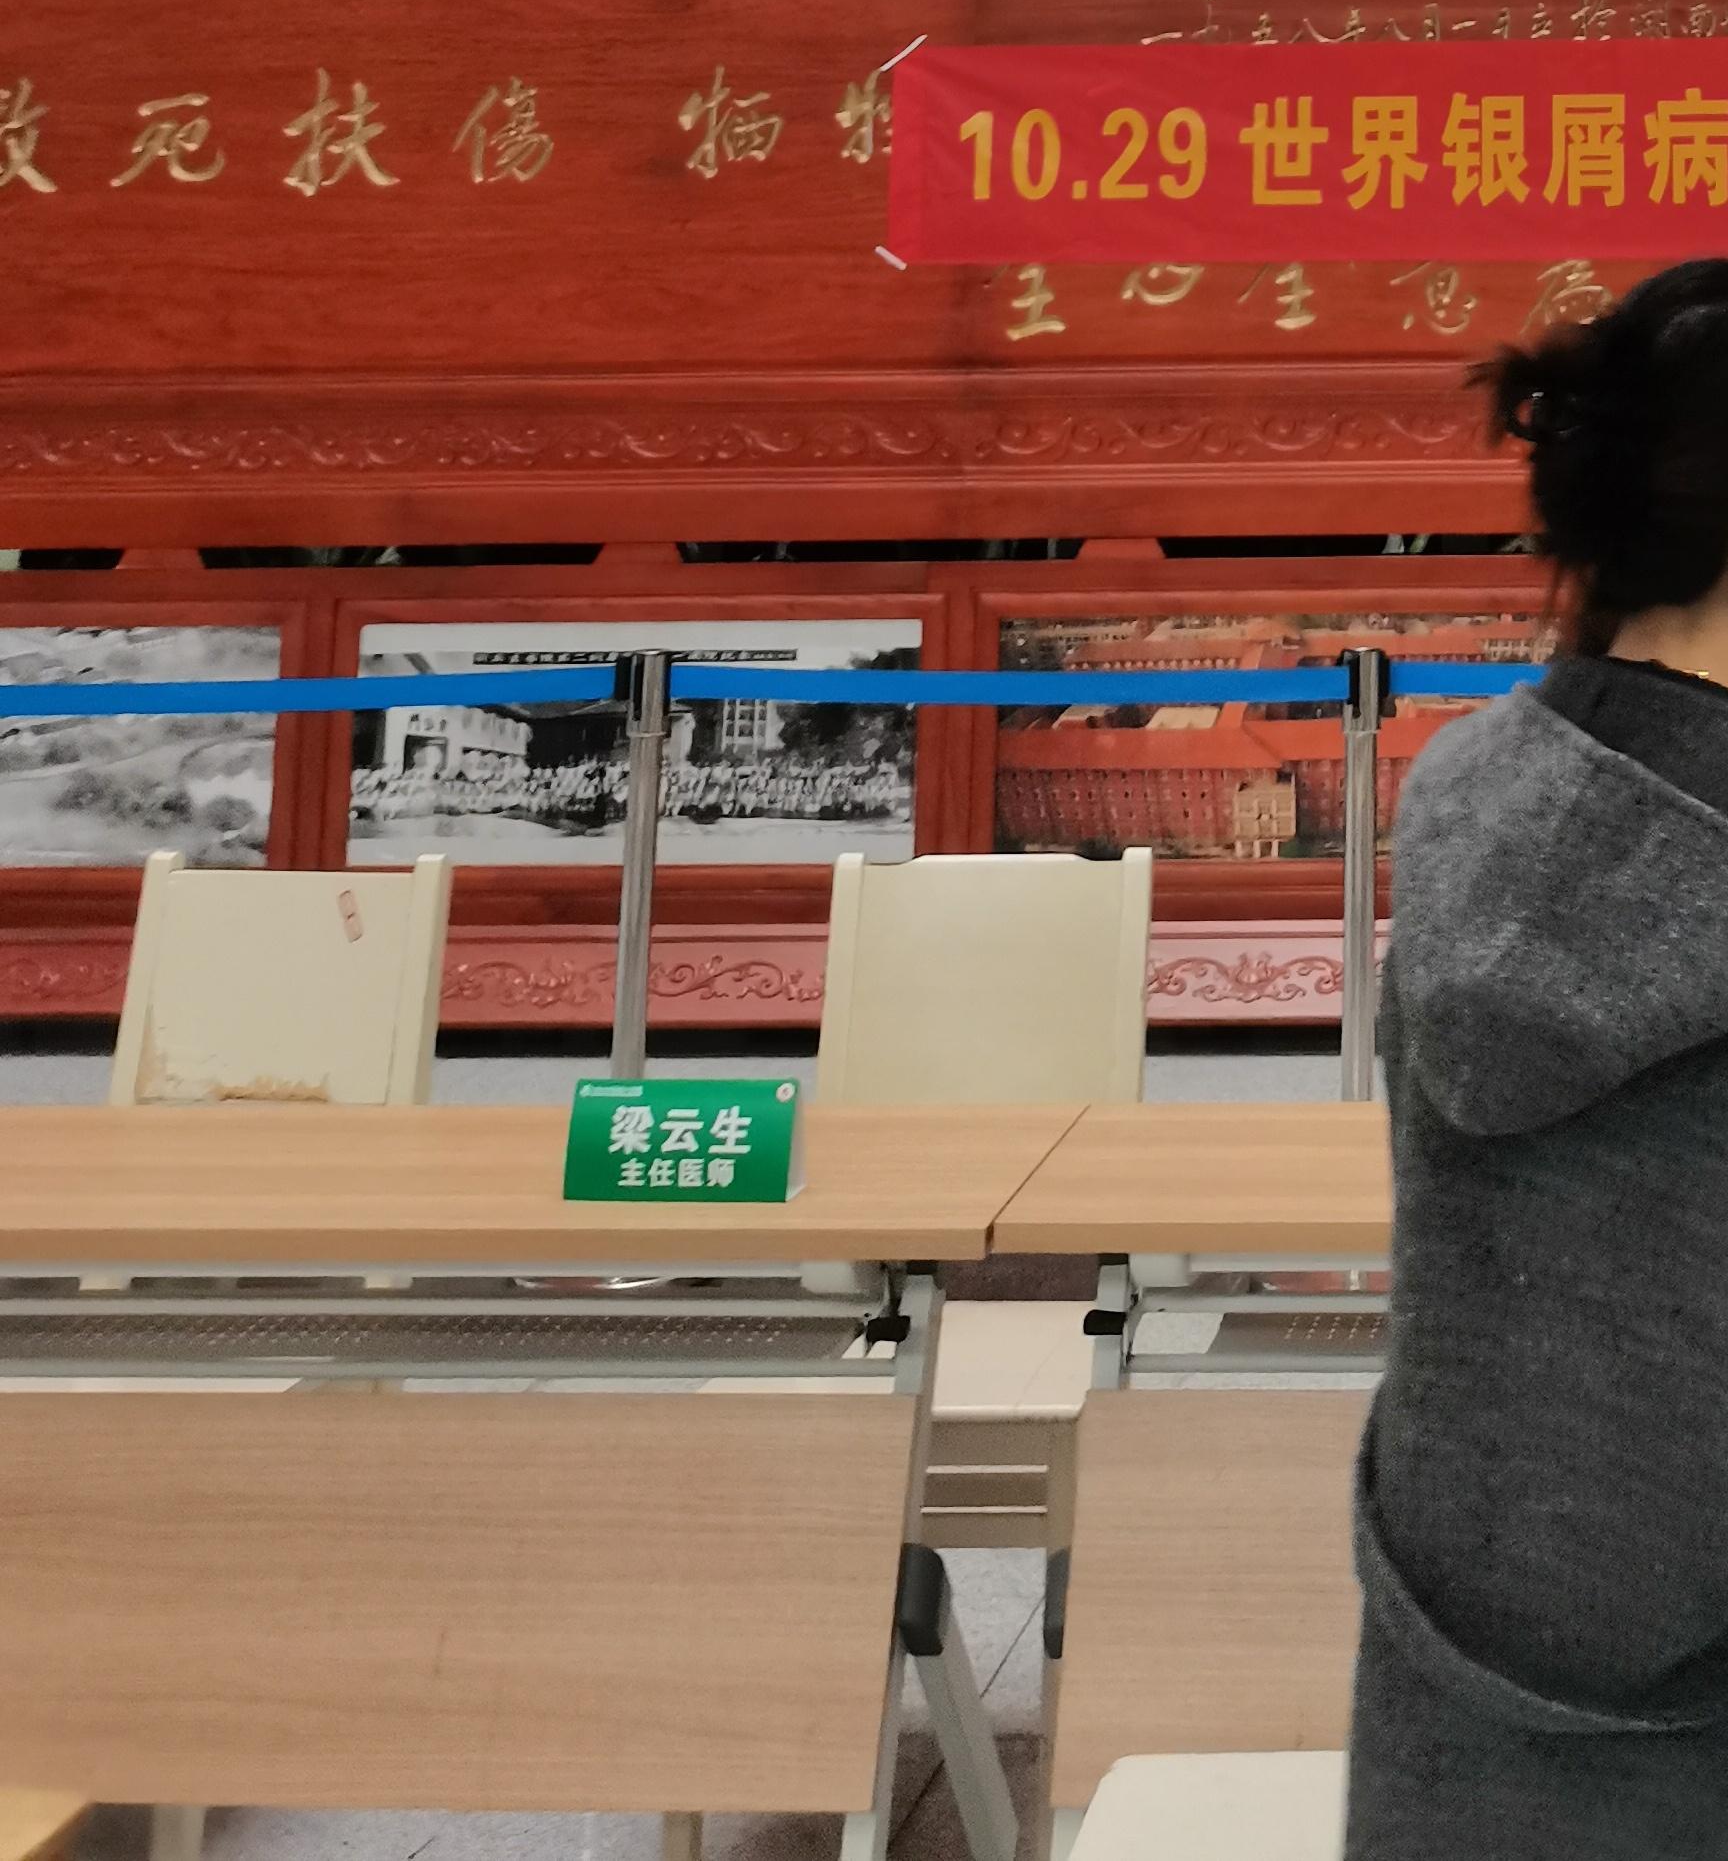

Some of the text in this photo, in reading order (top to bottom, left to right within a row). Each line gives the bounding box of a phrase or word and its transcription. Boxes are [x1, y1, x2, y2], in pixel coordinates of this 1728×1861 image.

[960, 106, 1208, 202] 10.29
[607, 1104, 752, 1155] 梁云生
[617, 1157, 736, 1188] 主任医师
